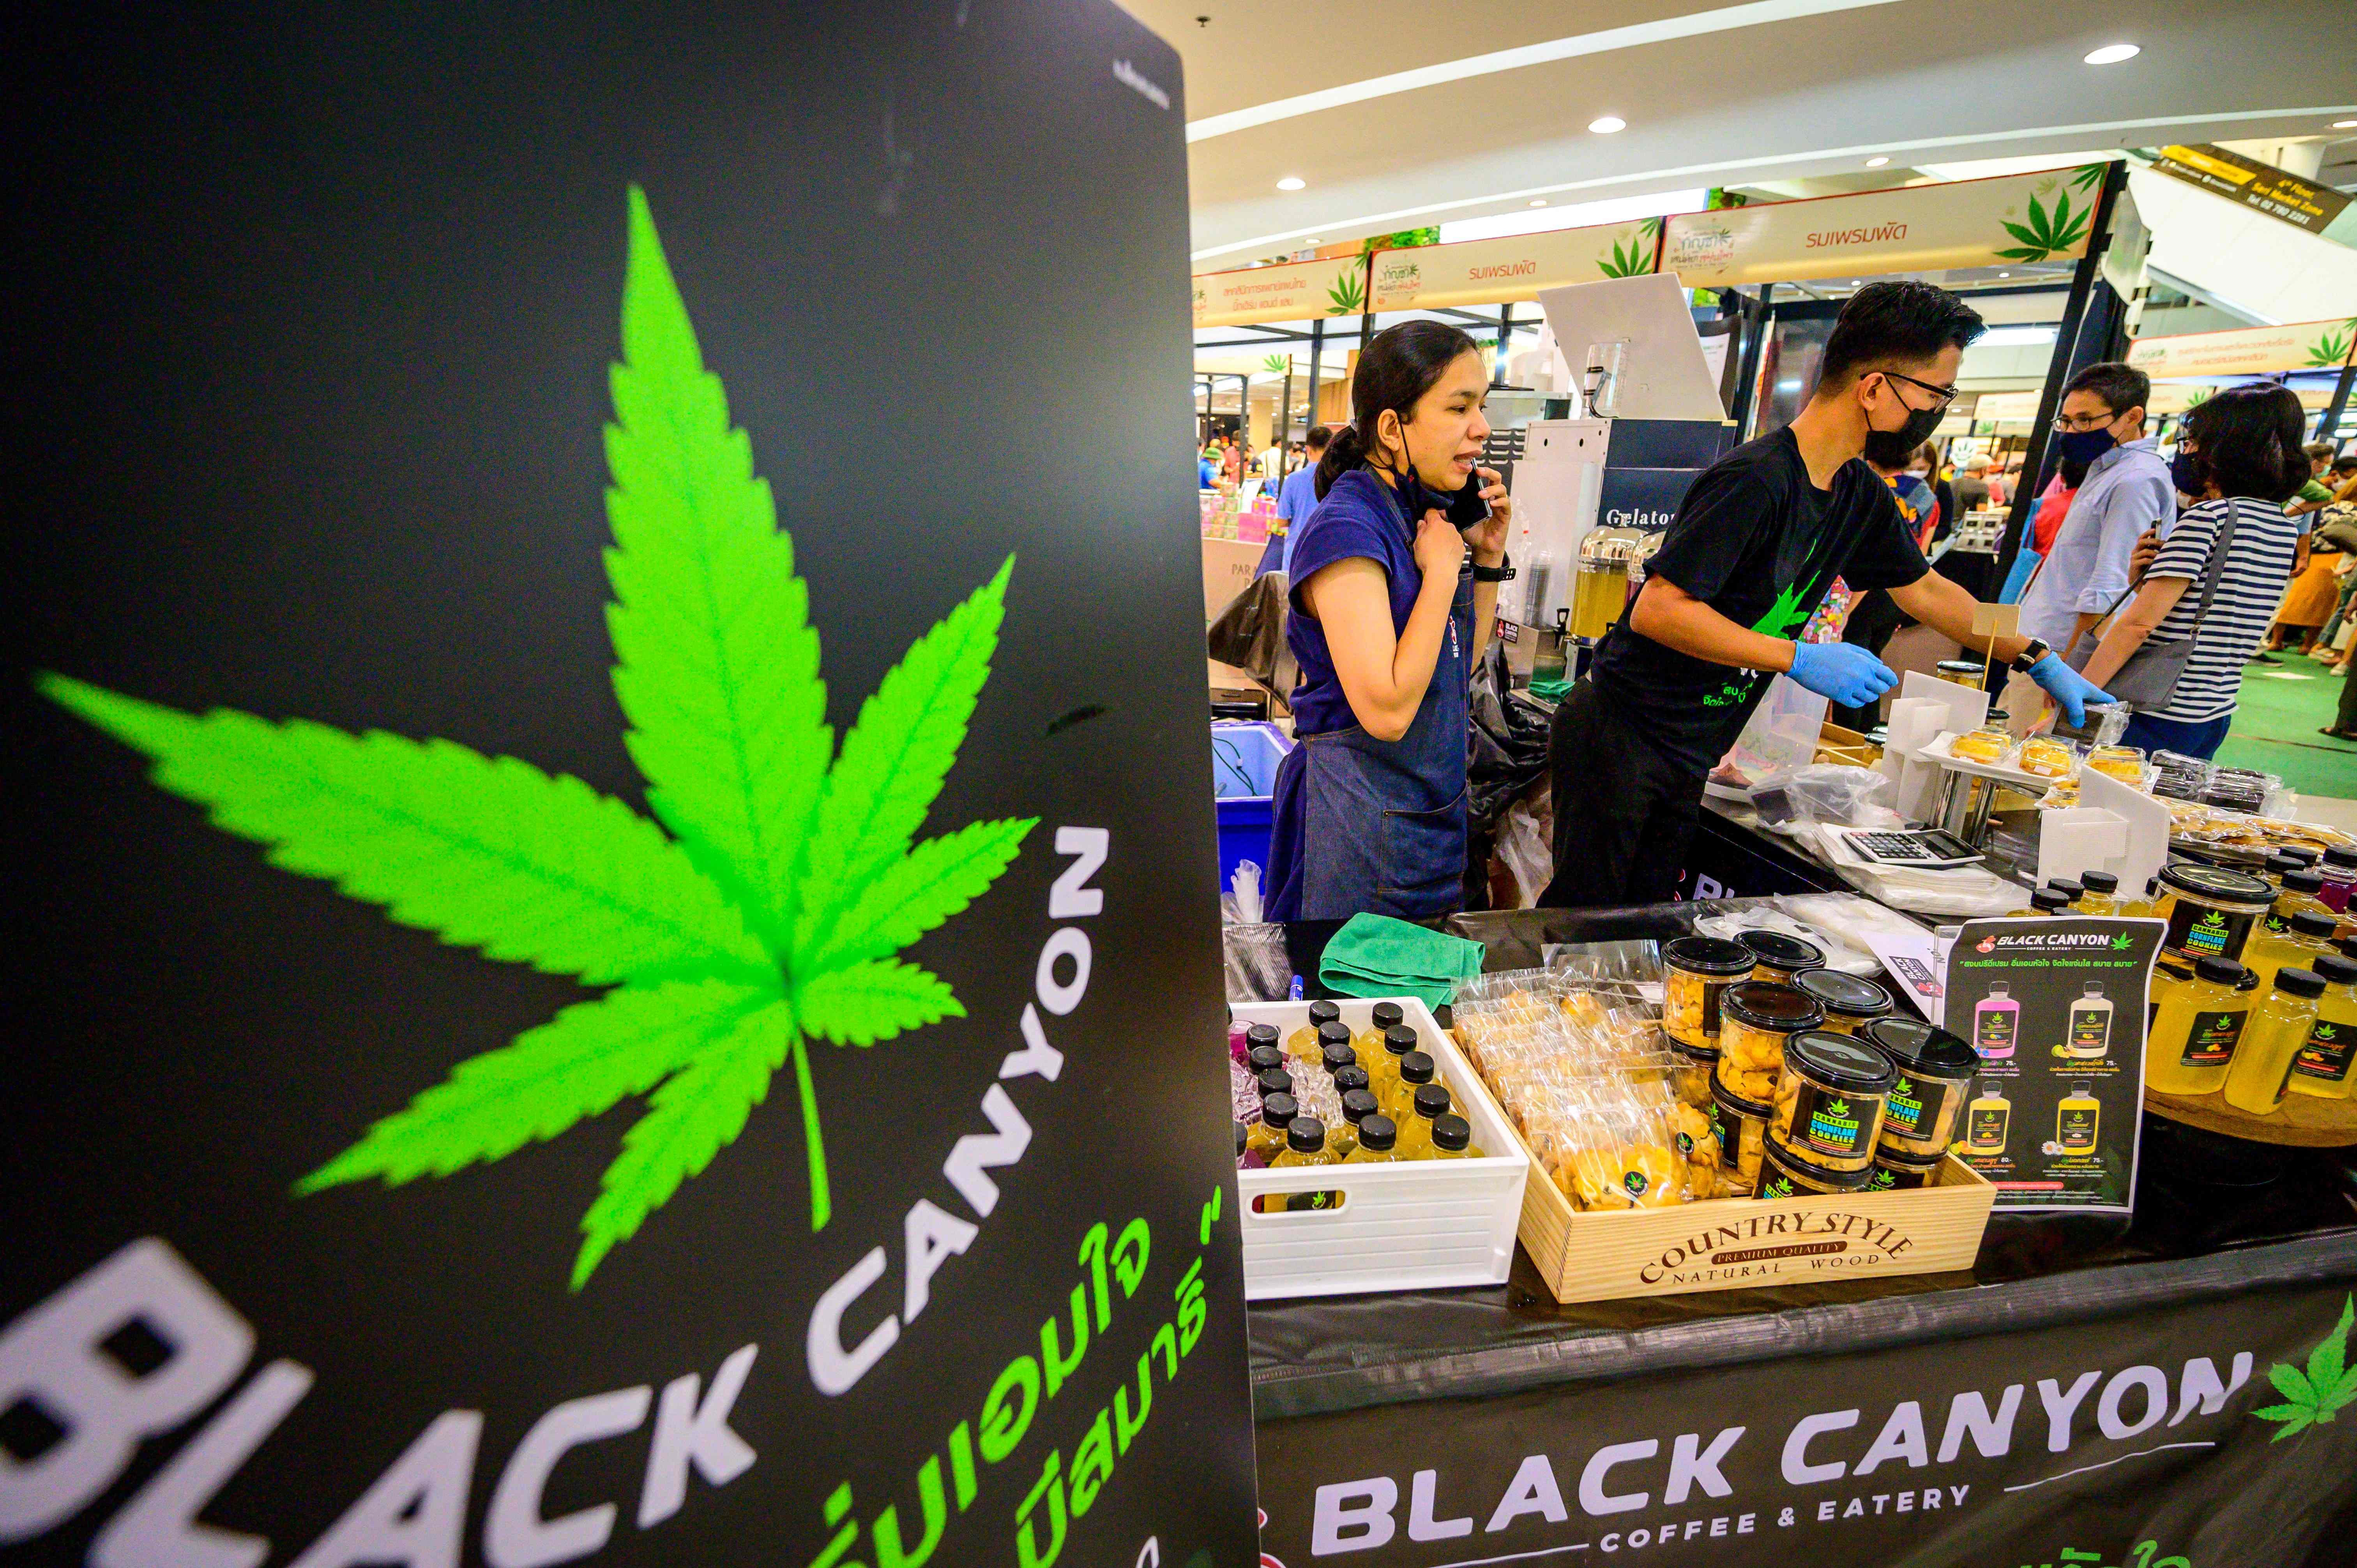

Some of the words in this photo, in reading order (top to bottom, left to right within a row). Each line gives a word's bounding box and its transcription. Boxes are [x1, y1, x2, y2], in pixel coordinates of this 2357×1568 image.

[1997, 935, 2046, 945] BLACK
[2047, 934, 2110, 945] CANYON
[2189, 931, 2226, 945] CORNFLAKE
[2193, 925, 2228, 936] CANNABIS
[2187, 938, 2224, 951] COOKIES
[1892, 957, 1919, 980] BLACK
[1902, 958, 1926, 981] CANYON
[1811, 1119, 1859, 1137] CORNFLAKE
[1815, 1113, 1857, 1128] CANNABIS
[1809, 1127, 1856, 1144] COOKIES
[0, 1234, 759, 1568] BLACK
[806, 825, 1110, 1396] CANYON
[1640, 1211, 1815, 1284] COUNTRY
[1820, 1212, 1914, 1260] STYLE
[1716, 1247, 1780, 1263] PREMIUM
[1782, 1243, 1841, 1257] QUALITY
[1671, 1263, 1782, 1284] NATURAL
[1810, 1254, 1880, 1270] WOOD
[1311, 1425, 1747, 1557] BLACK
[1780, 1351, 2254, 1485] CANYON
[1599, 1512, 1756, 1554] COFFEE
[1777, 1506, 1795, 1527] &
[1817, 1484, 1970, 1522] EATERY
